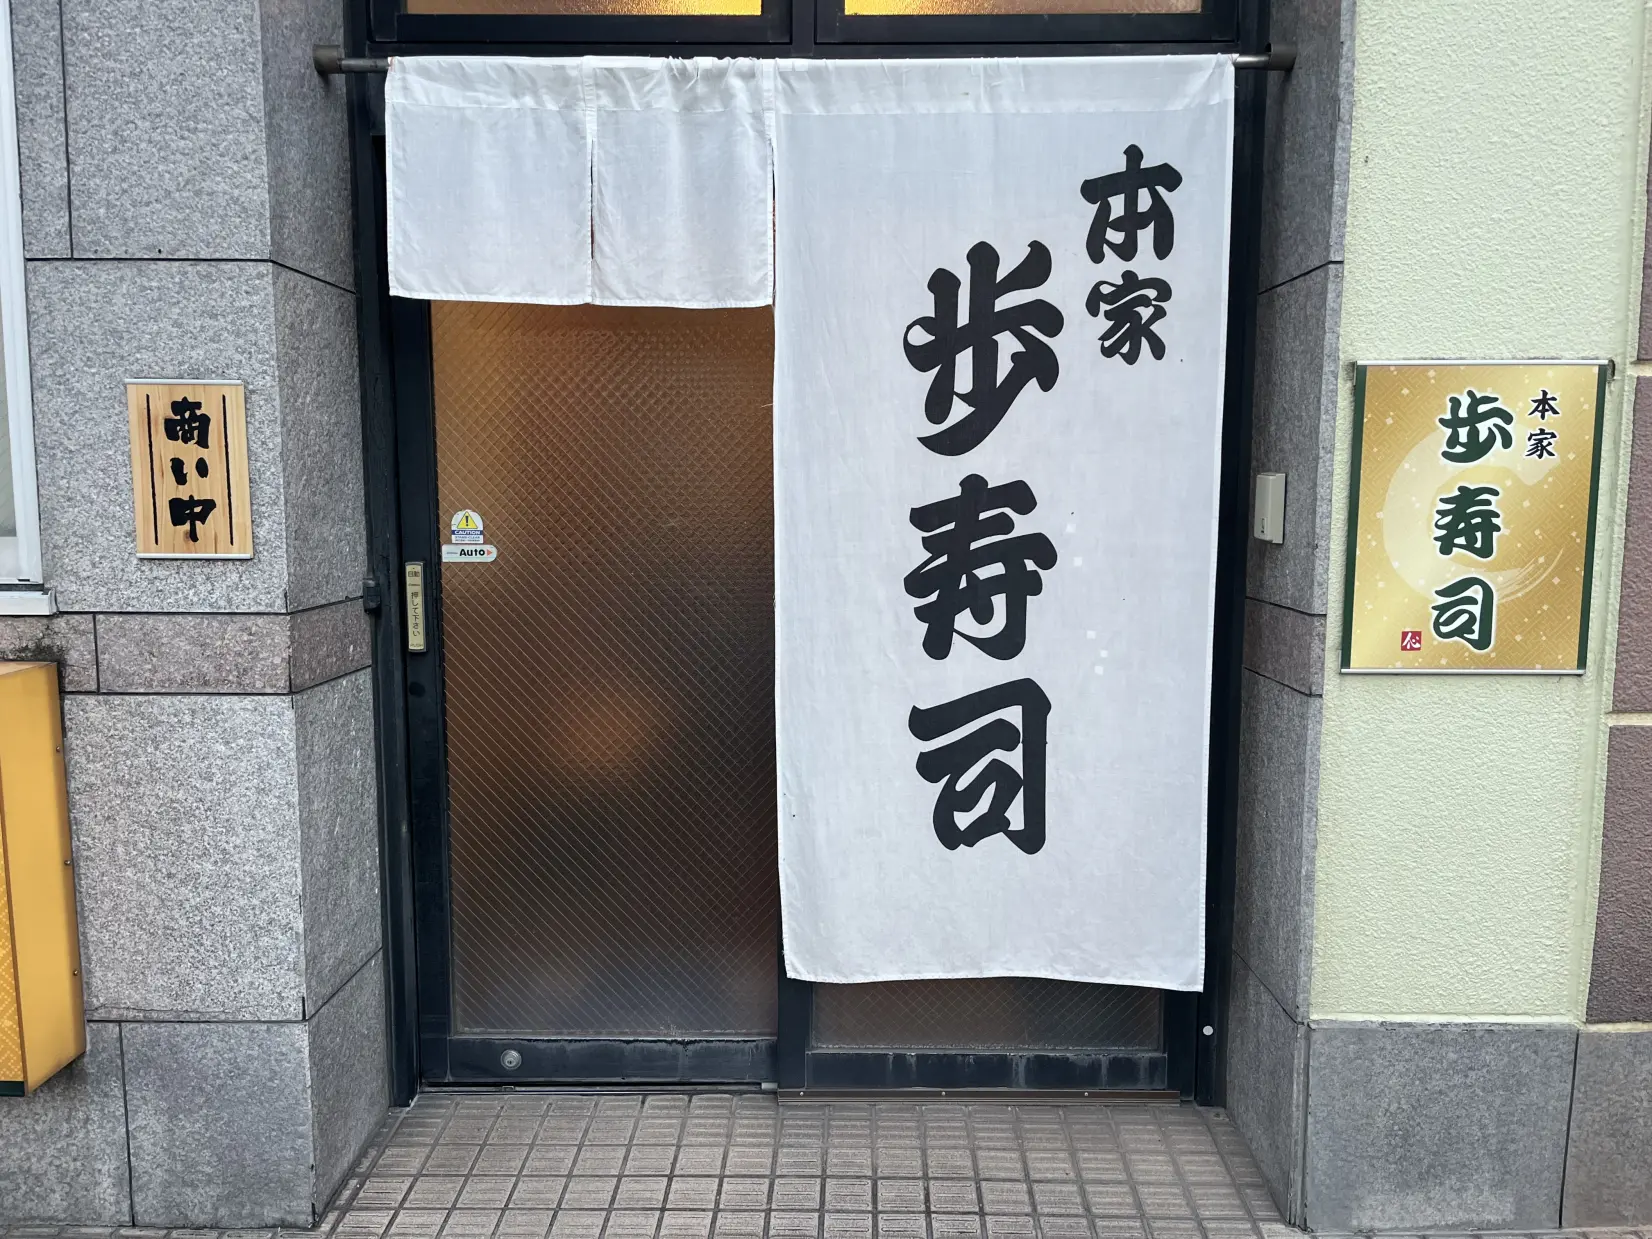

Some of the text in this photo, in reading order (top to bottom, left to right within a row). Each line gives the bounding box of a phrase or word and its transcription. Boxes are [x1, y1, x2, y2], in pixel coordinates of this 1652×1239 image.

[1081, 144, 1183, 366] 本家
[164, 396, 216, 542] 商い中
[1525, 389, 1560, 460] 本家
[459, 548, 486, 557] Auto
[903, 240, 1065, 855] 歩寿司
[1431, 389, 1514, 651] 歩寿司
[411, 591, 421, 637] 押して下さい
